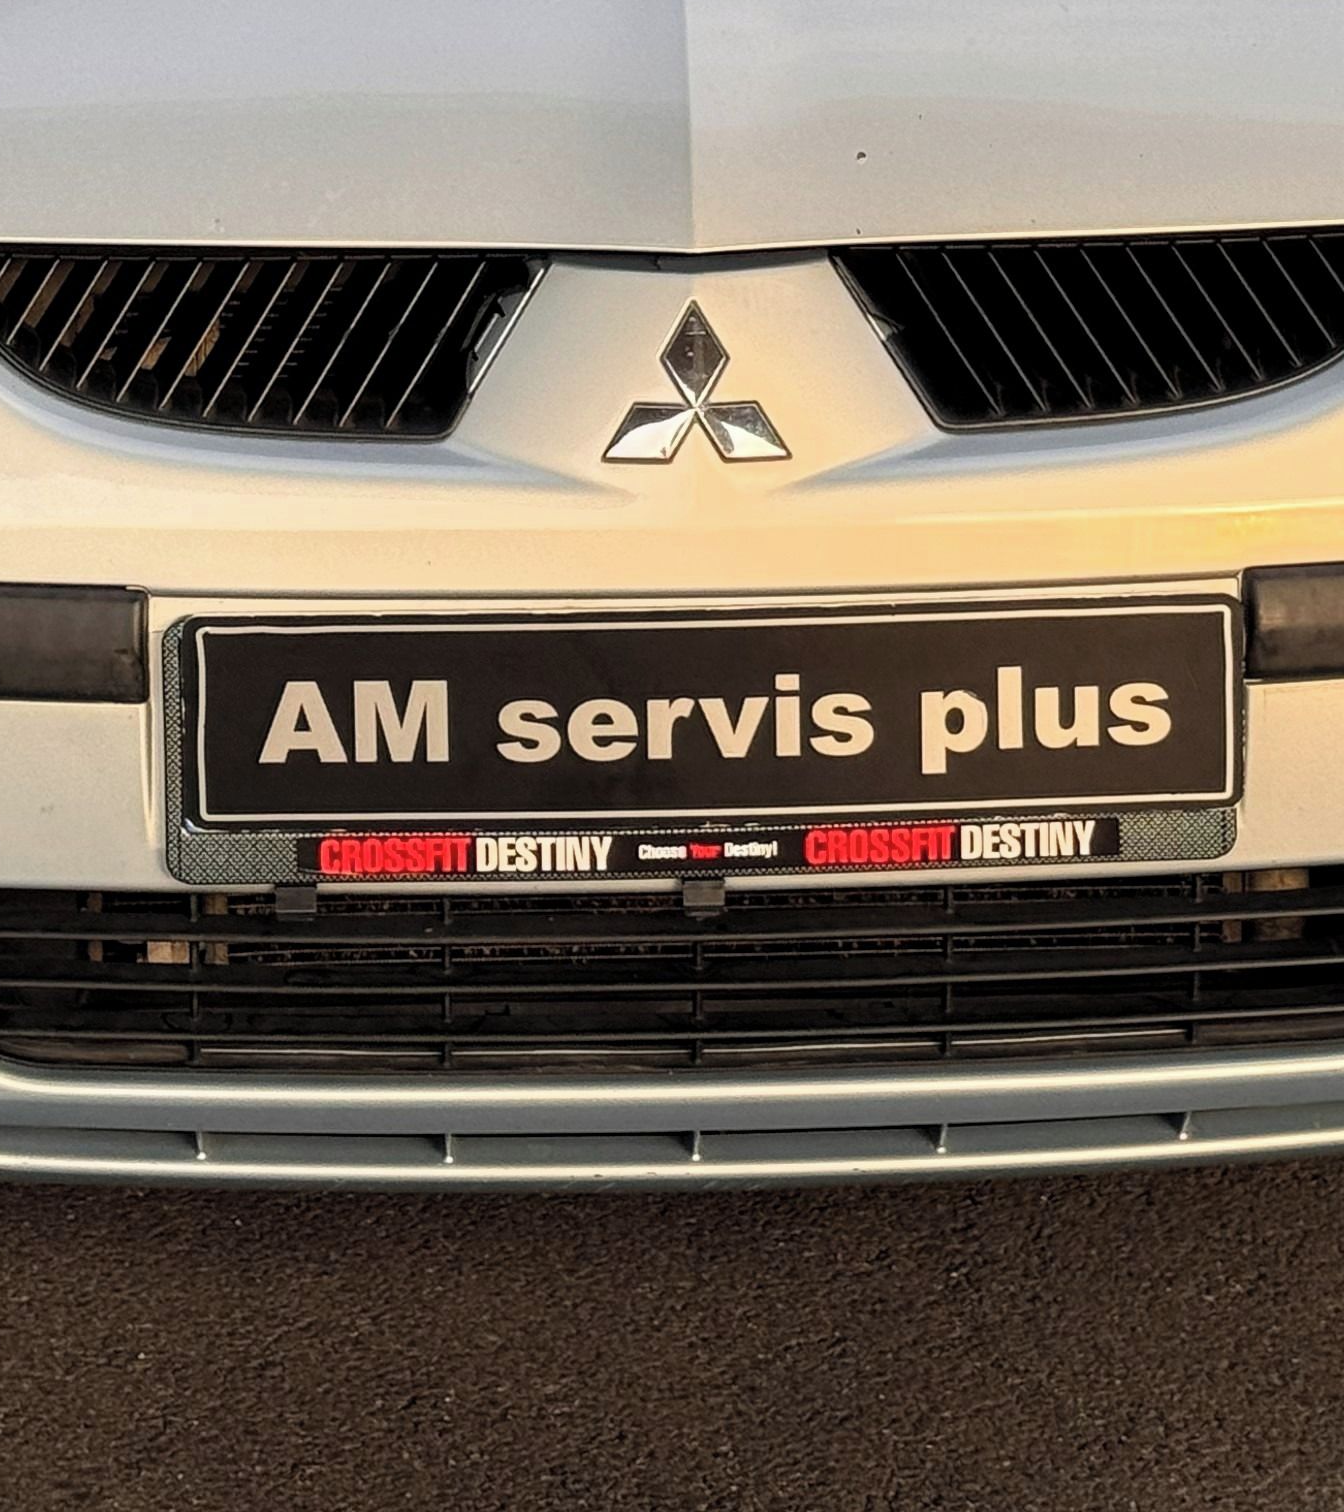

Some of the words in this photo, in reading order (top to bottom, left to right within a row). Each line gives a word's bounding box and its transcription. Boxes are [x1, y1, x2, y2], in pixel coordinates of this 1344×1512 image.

[258, 679, 450, 764] AM
[496, 673, 875, 763] servis
[920, 666, 1172, 775] plus
[319, 837, 472, 874] CROSSFIT
[476, 836, 613, 872] DESTINY
[689, 842, 722, 859] Your
[724, 840, 778, 859] Destiny!
[806, 825, 956, 864] CROSSFIT
[960, 820, 1096, 860] DESTINY
